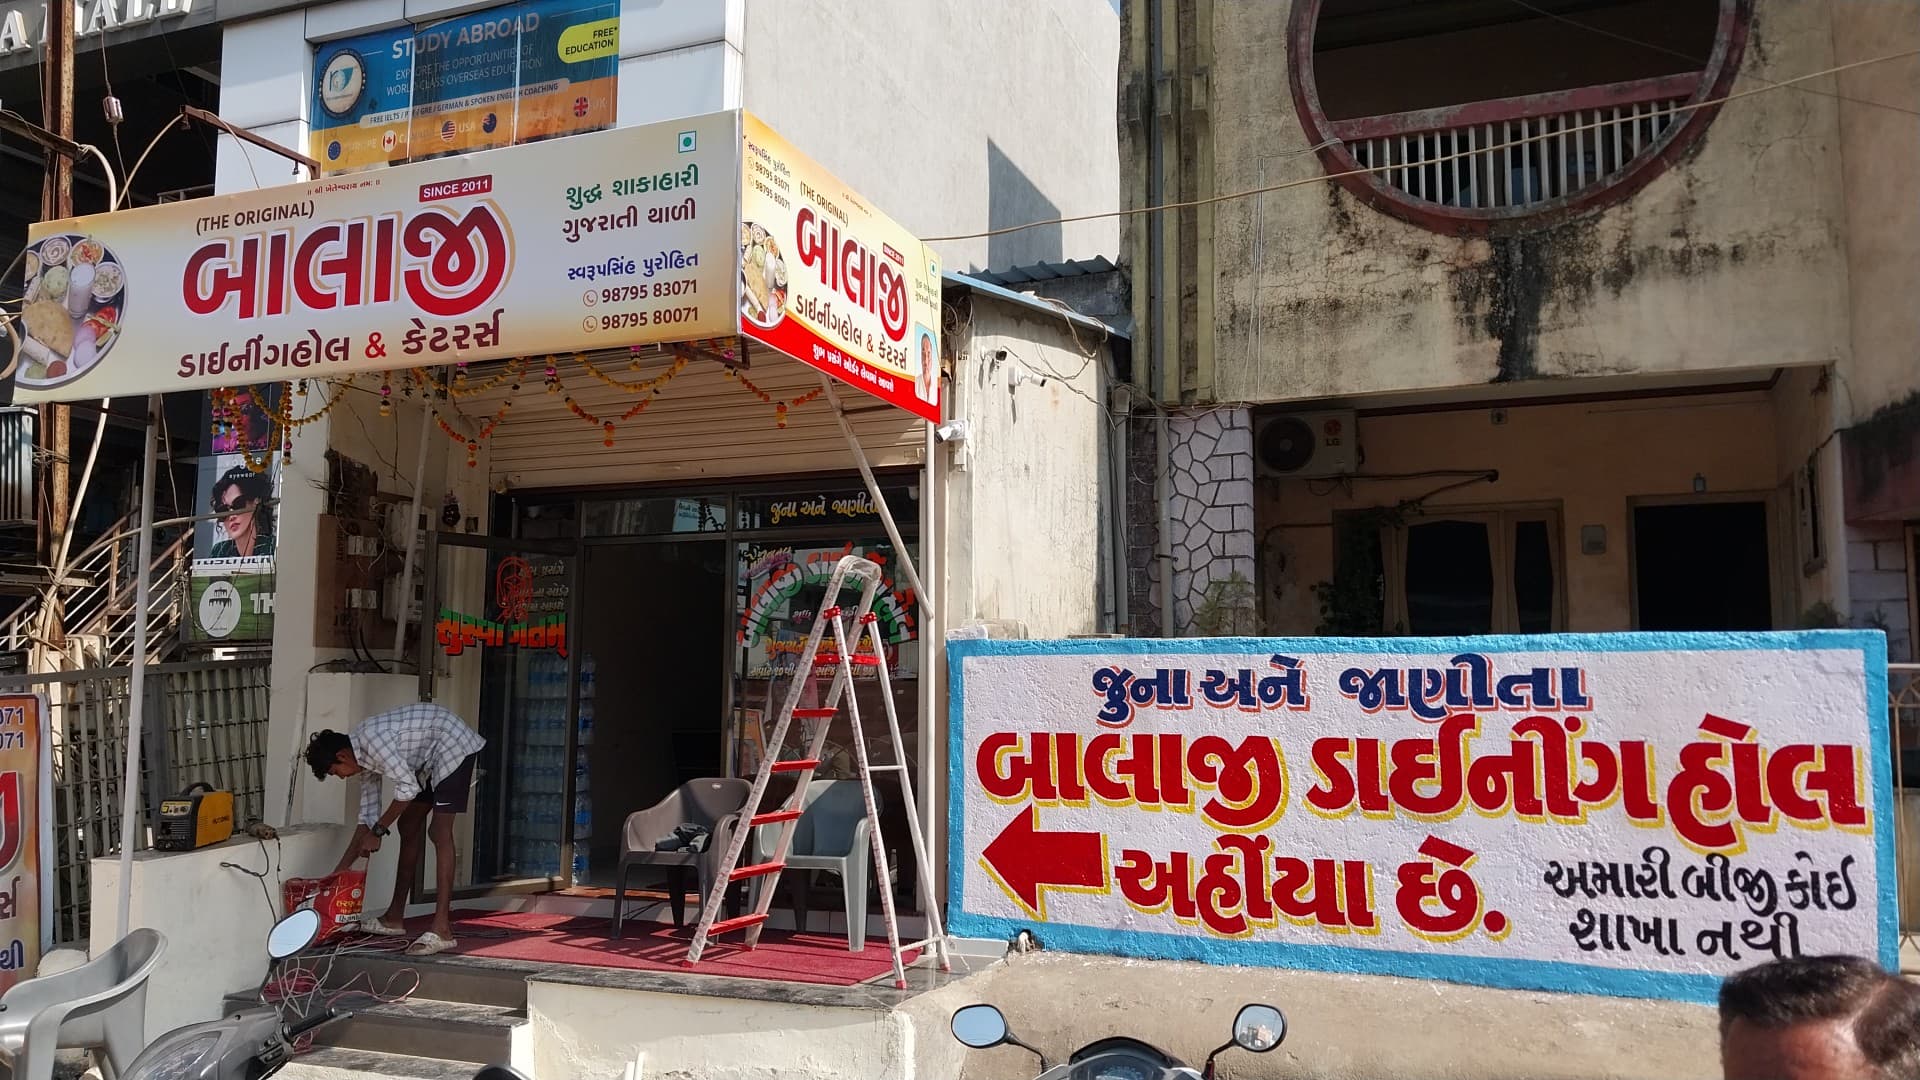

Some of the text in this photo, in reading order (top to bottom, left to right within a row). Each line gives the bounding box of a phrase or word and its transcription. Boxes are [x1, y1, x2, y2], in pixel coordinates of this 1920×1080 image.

[392, 12, 540, 60] STUDY ABROAD
[565, 38, 614, 55] EDUCATION
[396, 64, 432, 80] EXPORE
[435, 60, 450, 72] THE
[522, 44, 534, 56] OF
[447, 67, 489, 85] OVERSEAS
[369, 115, 383, 124] FREE
[384, 112, 400, 122] IELTS
[420, 105, 433, 114] GRE
[437, 100, 464, 112] GERMAN
[470, 95, 495, 106] SPOKEN
[497, 89, 523, 101] ENGLIH
[524, 83, 558, 96] COACHING
[459, 122, 476, 132] USA
[423, 180, 489, 198] SINCE 2011
[566, 163, 699, 210] શુદ્ધ શાકાહારી
[755, 161, 790, 193] 98795 83071
[755, 180, 773, 199] 98795
[196, 200, 315, 235] (THE ORIGINAL)
[562, 197, 696, 243] ગુજરાતી થાળી
[799, 180, 816, 202] (THE
[816, 193, 849, 228] ORIGINAL)
[183, 203, 511, 319] બાલાજી
[567, 250, 699, 281] સ્વરૂપસિંહ પુરોહિત
[796, 207, 909, 342] બાલાજી
[602, 279, 697, 303] 98795 83071
[364, 331, 386, 359] &
[402, 308, 504, 355] કેટરર્સ
[601, 307, 699, 330] 98795 80071
[866, 333, 874, 353] &
[878, 333, 908, 371] કેટરર્સ
[1326, 438, 1340, 447] LG
[228, 472, 256, 480] eyewear
[800, 495, 827, 517] અને
[1092, 653, 1594, 728] જુના અને જાણીતા
[976, 713, 1874, 854] બાલાજી ડાઈનીંગ હોલ
[1114, 833, 1512, 942] અહીંયા છે.
[1543, 846, 1858, 918] અમારી બીજી કોઈ
[1568, 908, 1801, 961] શાખા નથી
